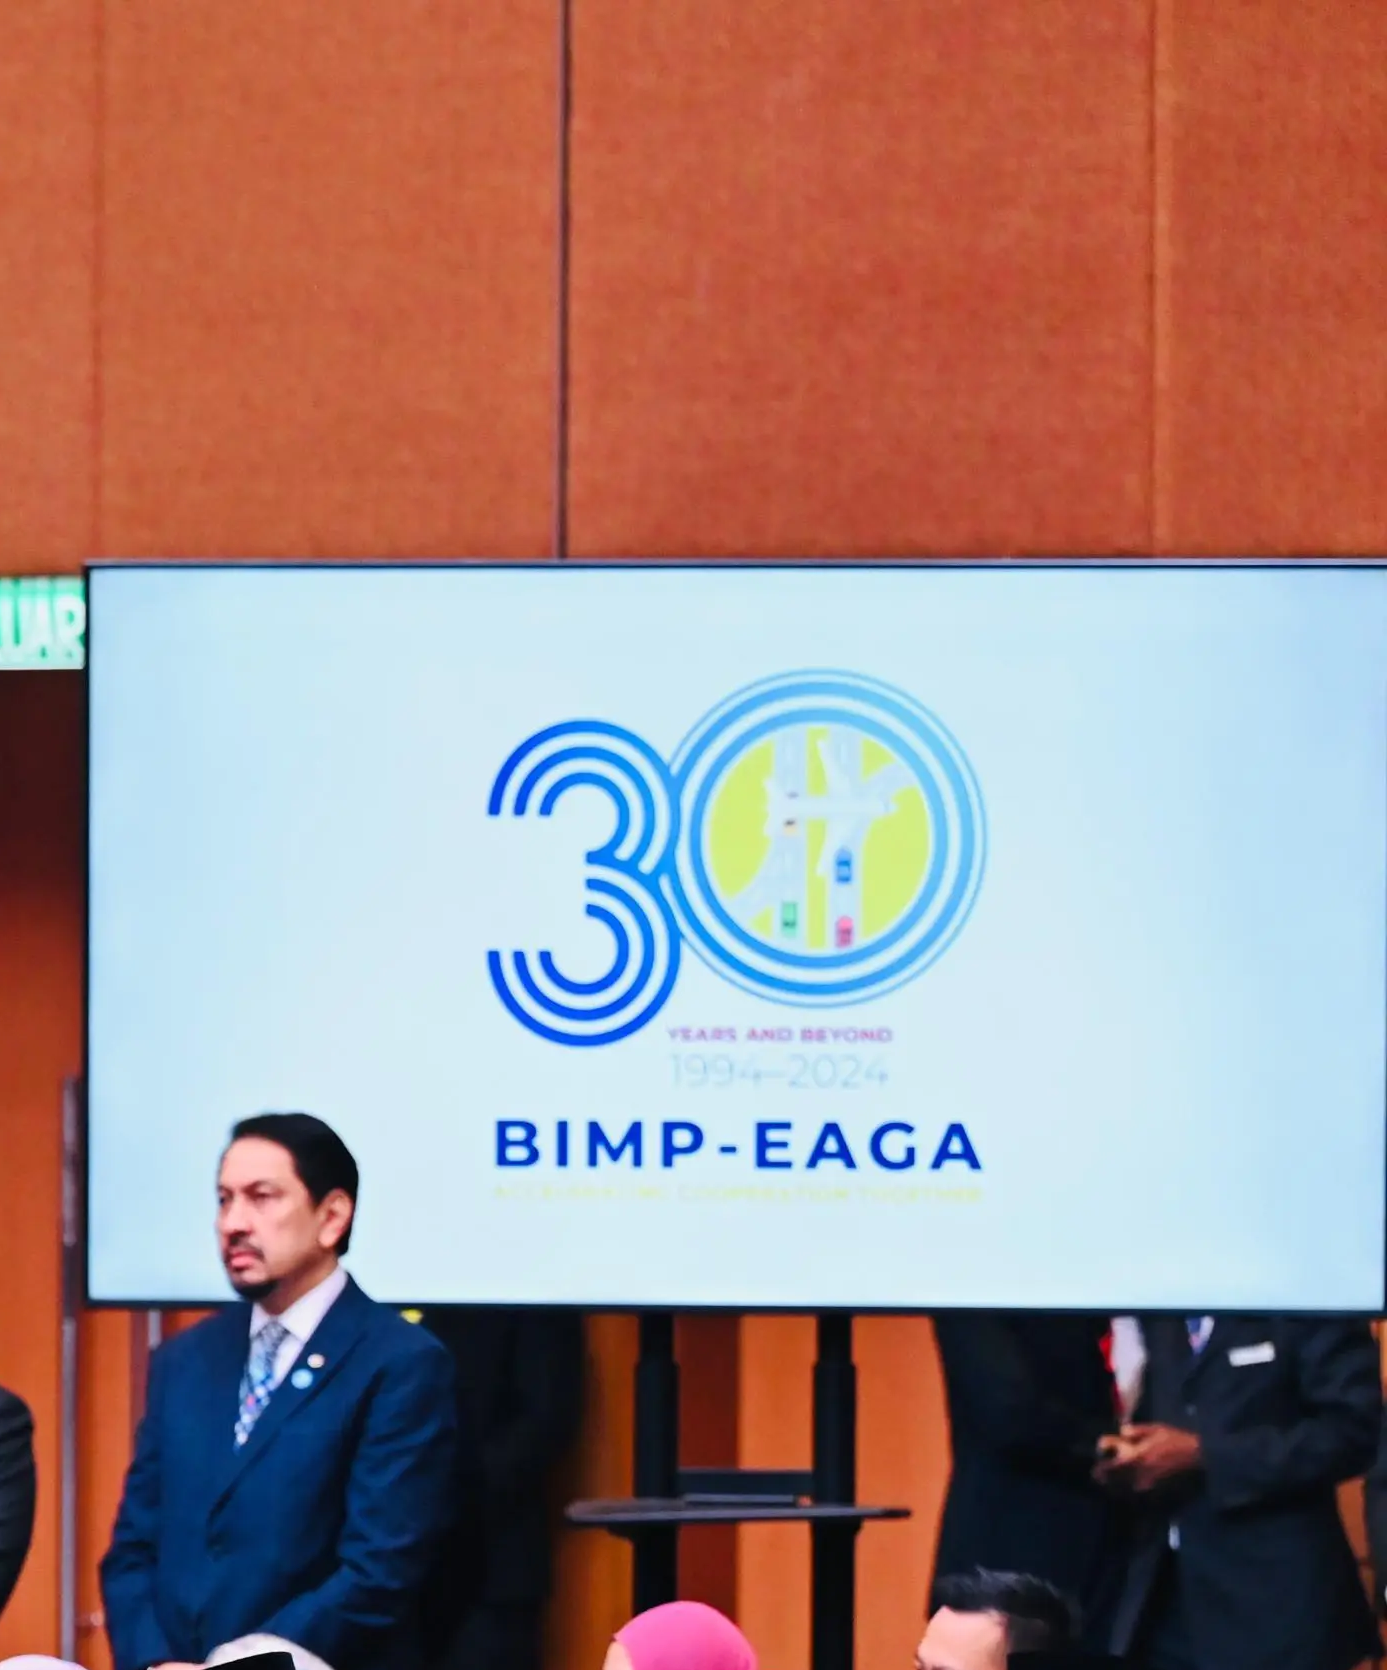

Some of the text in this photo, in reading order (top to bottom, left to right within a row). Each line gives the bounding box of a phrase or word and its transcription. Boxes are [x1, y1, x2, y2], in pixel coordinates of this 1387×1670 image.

[487, 668, 988, 1048] 30
[667, 1027, 894, 1043] YEARS AND BEYOND
[494, 1120, 982, 1171] BIMP-EAGA
